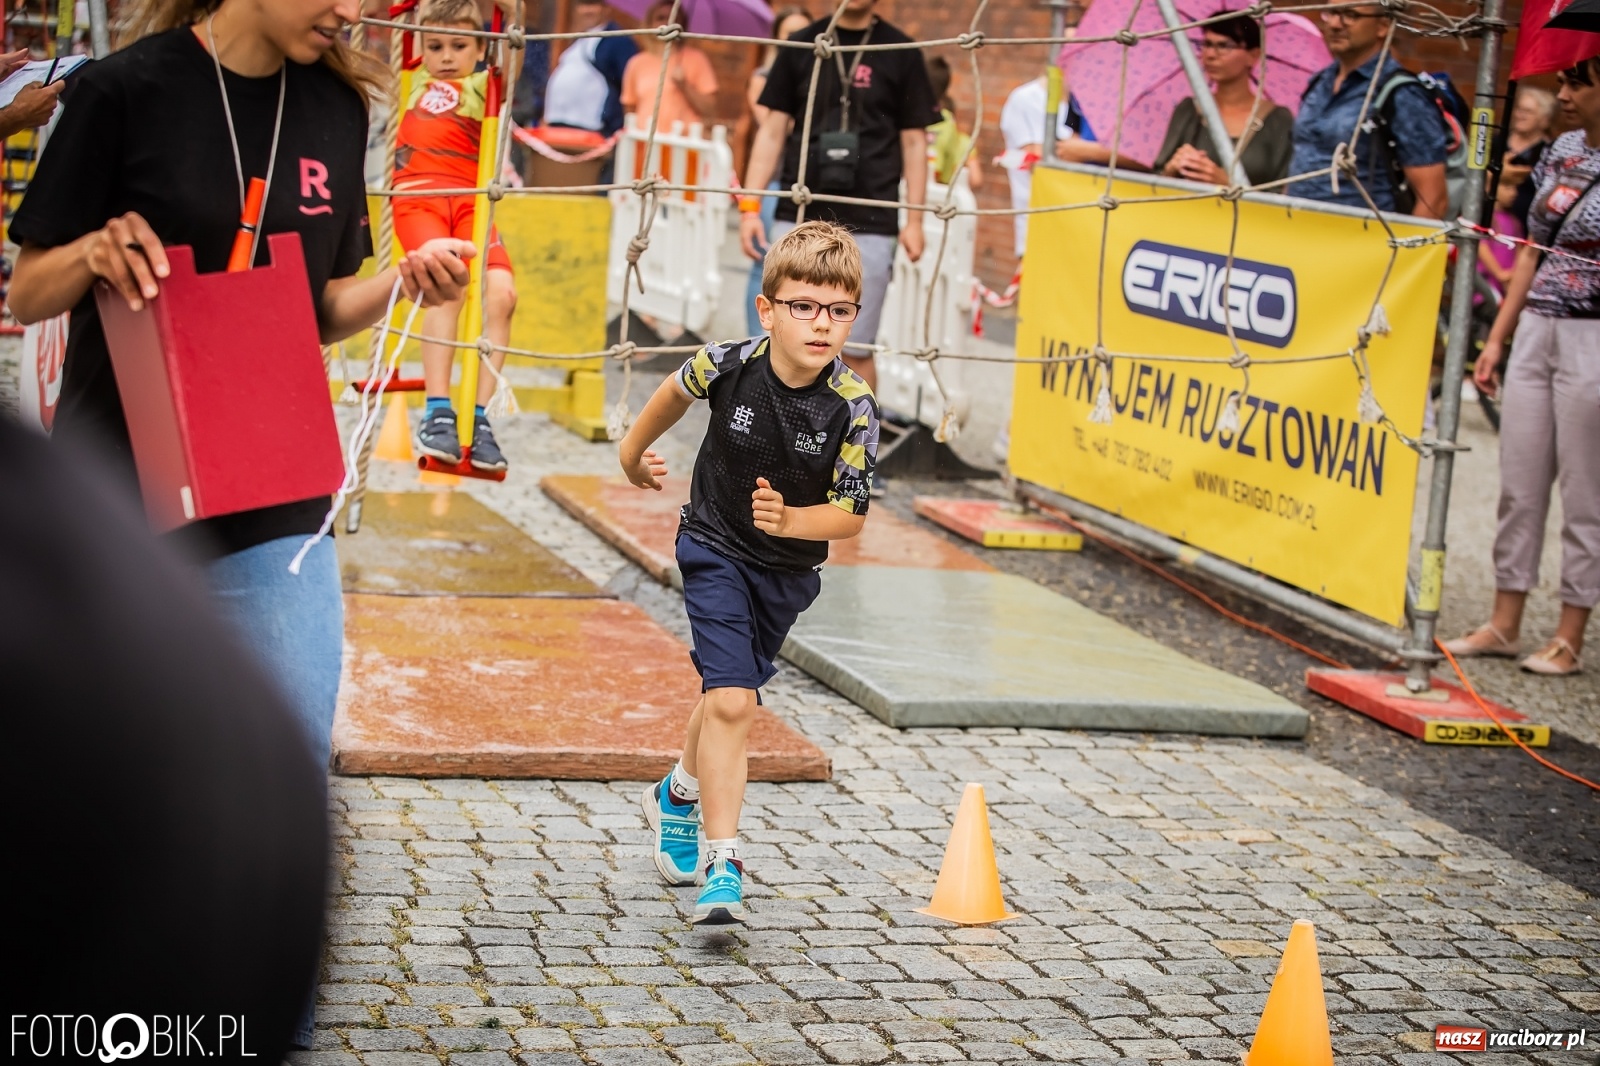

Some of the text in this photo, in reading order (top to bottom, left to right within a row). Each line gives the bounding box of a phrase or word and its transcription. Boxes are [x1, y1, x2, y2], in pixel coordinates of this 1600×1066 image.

[299, 157, 331, 200] R
[1123, 248, 1295, 338] ERIGO
[795, 439, 822, 452] MORE
